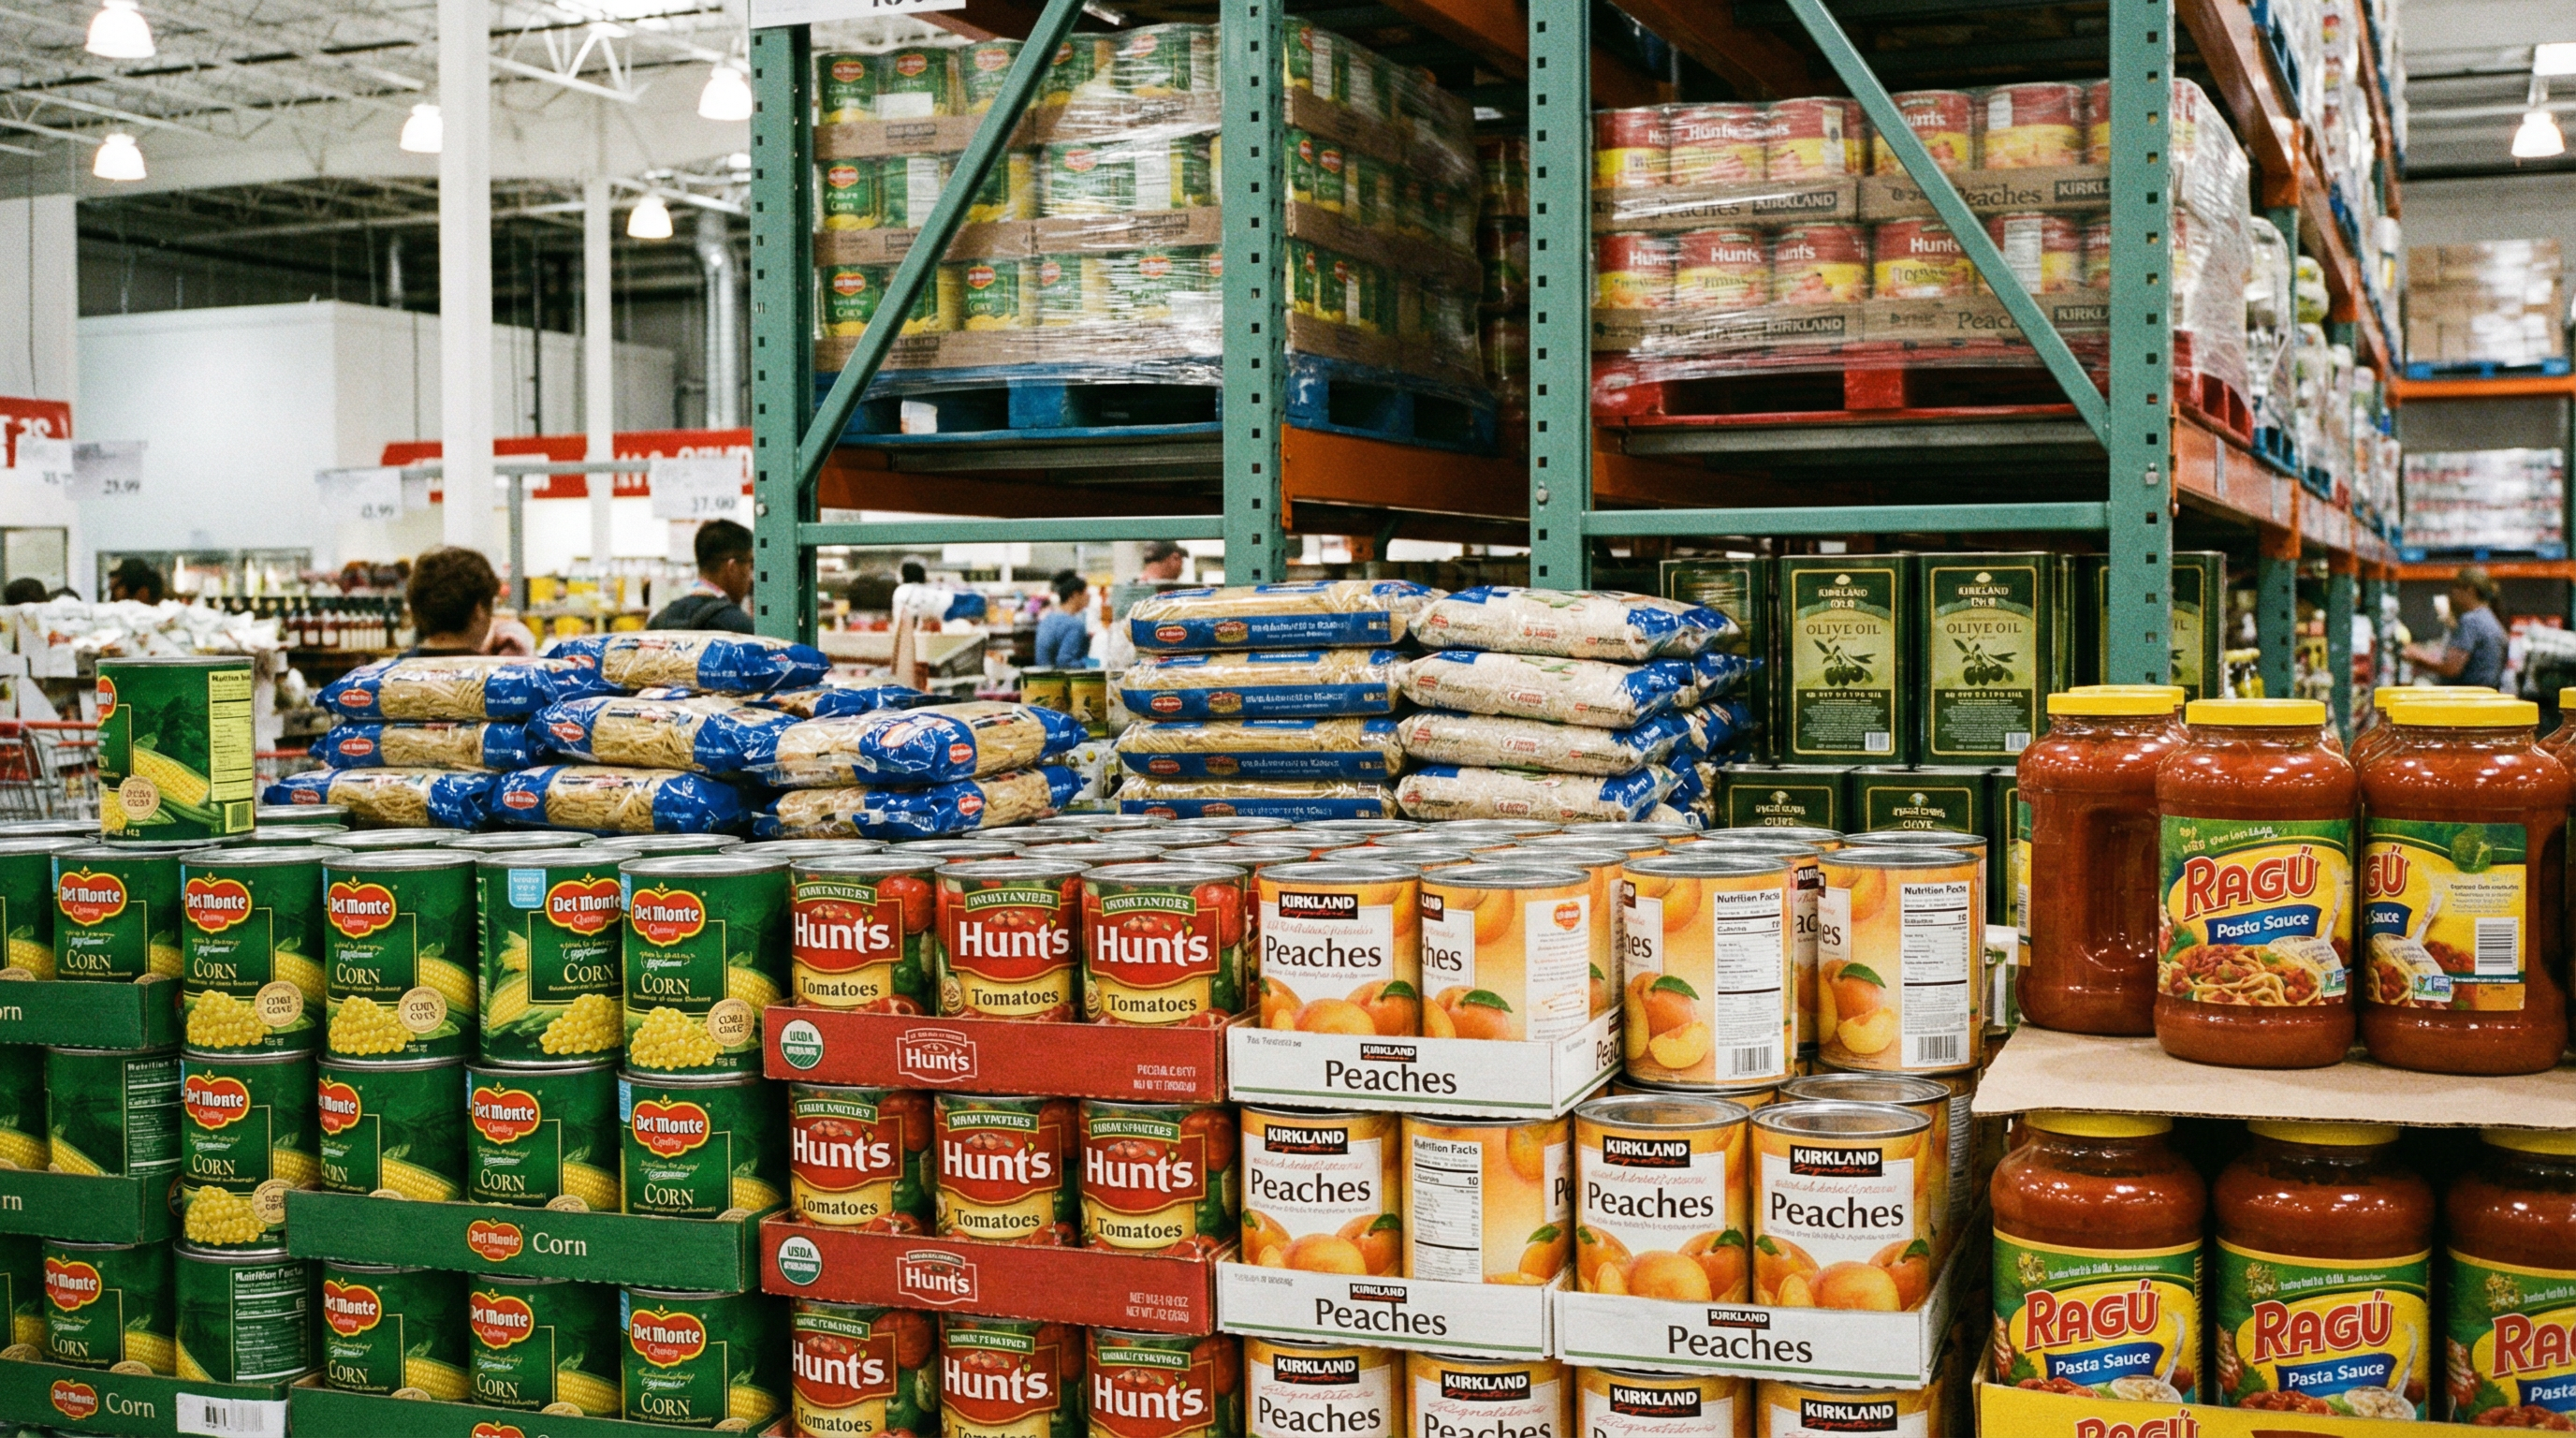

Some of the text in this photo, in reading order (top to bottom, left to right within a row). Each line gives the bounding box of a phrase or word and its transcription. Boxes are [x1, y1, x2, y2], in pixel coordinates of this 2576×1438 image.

[2057, 181, 2106, 196] KIRKL
[1958, 311, 2013, 330] Peac
[2057, 306, 2106, 320] KIRKL
[1806, 624, 1881, 642] OLIVE OIL
[1946, 623, 2022, 640] OLIVE OIL
[2365, 844, 2410, 898] GÚ
[2183, 844, 2320, 922] RAGÚ
[78, 888, 121, 903] Monte
[202, 894, 245, 910] Monte
[553, 894, 622, 912] Del Monte
[1281, 894, 1355, 910] KIRKLAND
[346, 899, 390, 915] Monte
[635, 903, 700, 922] Del Monte
[2370, 909, 2400, 924] Sauce
[2217, 913, 2310, 938] Pasta Sauce
[1266, 934, 1382, 968] Peaches
[641, 972, 691, 995] CORN
[800, 976, 878, 997] Tomatoes
[971, 988, 1060, 1007] Tomatoes
[1107, 994, 1197, 1013] Tomatoes
[0, 1005, 22, 1020] rn
[905, 1047, 970, 1073] Hunt's
[1325, 1059, 1457, 1094] Peaches
[201, 1090, 244, 1108] Monte
[491, 1104, 535, 1122] Monte
[637, 1114, 704, 1134] Del Monte
[1267, 1127, 1345, 1145] KIRKLAND
[1606, 1138, 1688, 1156] KIRKLAND
[1793, 1148, 1880, 1166] KIRKLAND
[480, 1168, 526, 1192] CORN
[1251, 1167, 1371, 1203] Peaches
[1467, 1176, 1479, 1186] 10
[3, 1195, 22, 1211] rn
[644, 1182, 695, 1207] CORN
[1588, 1181, 1714, 1218] Peaches
[799, 1194, 879, 1216] Tomatoes
[1771, 1191, 1904, 1228] Peaches
[954, 1208, 1041, 1230] Tomatoes
[1095, 1218, 1183, 1240] Tomatoes
[532, 1231, 588, 1256] Corn
[787, 1245, 813, 1259] USDA
[59, 1273, 97, 1291] Monte
[905, 1267, 971, 1296] Hunt's
[1352, 1284, 1405, 1298] KIRKLAND
[337, 1298, 376, 1316] Monte
[2023, 1278, 2161, 1353] RAGÚ
[486, 1309, 529, 1328] Monte
[1315, 1298, 1447, 1336] Peaches
[1710, 1311, 1768, 1323] KIRKLAND
[634, 1323, 700, 1344] Del Monte
[2251, 1288, 2394, 1366] RAGÚ
[1667, 1325, 1813, 1363] Peaches
[2491, 1313, 2576, 1380] RA
[1277, 1357, 1356, 1373] KIRKLAND
[2056, 1353, 2151, 1376] Pasta Sauce
[1444, 1373, 1528, 1390] KIRKLAND
[2288, 1363, 2385, 1387] Pasta Sauce
[1614, 1387, 1697, 1405] KIRKLAND
[2530, 1384, 2576, 1402] Pasta
[106, 1392, 155, 1418] Corn
[640, 1391, 691, 1416] CORN
[1805, 1401, 1895, 1419] KIRKLAND
[798, 1406, 873, 1432] Tomatoes
[1258, 1396, 1381, 1433] Peaches
